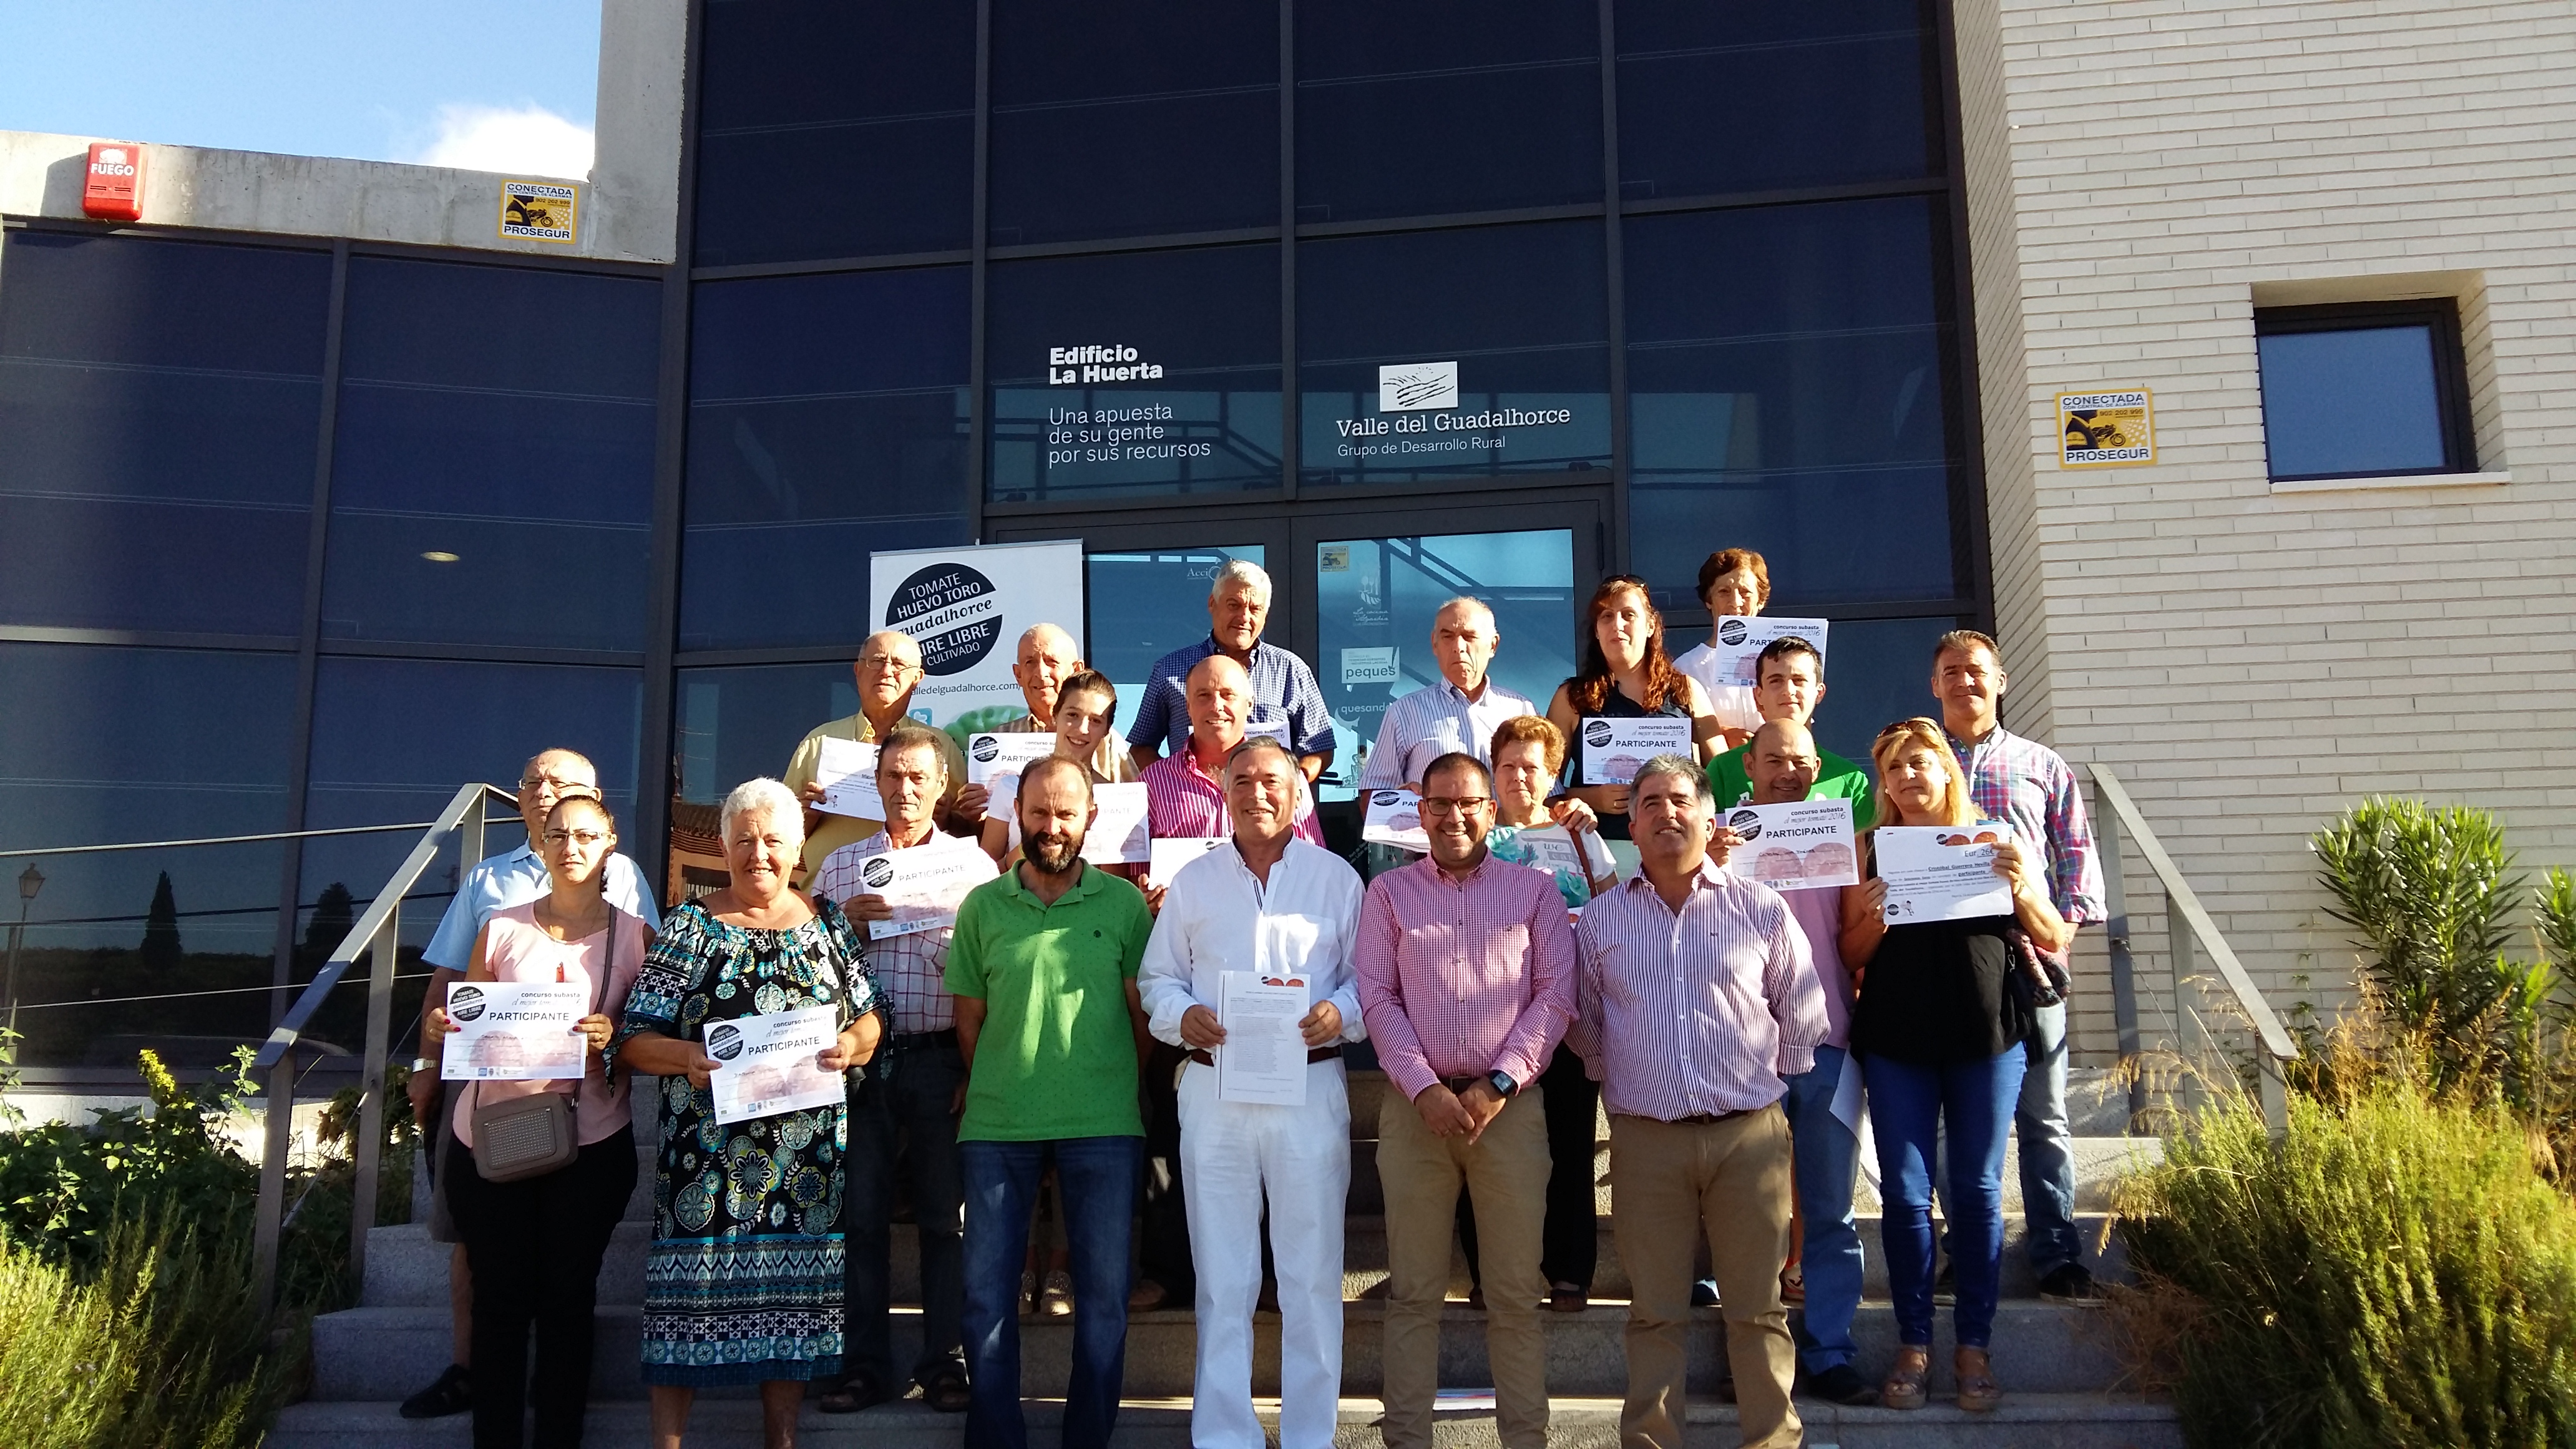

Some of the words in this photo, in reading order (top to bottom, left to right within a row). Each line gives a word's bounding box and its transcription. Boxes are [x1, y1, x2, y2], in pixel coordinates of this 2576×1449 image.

[90, 163, 134, 175] FUEGO
[507, 183, 572, 195] CONECTADA
[504, 226, 570, 238] PROSEGUR
[1050, 344, 1138, 365] Edificio
[1050, 367, 1076, 384] La
[1083, 362, 1163, 383] Huerta
[2062, 394, 2144, 406] CONECTADA
[1050, 407, 1089, 426] Una
[1095, 402, 1173, 427] apuesta
[1336, 418, 1389, 437] Valle
[1395, 414, 1428, 434] del
[1434, 408, 1571, 432] Guadalhorce
[1049, 426, 1073, 444] de
[1079, 430, 1101, 443] su
[1108, 422, 1164, 447] gente
[1049, 449, 1081, 469] por
[1086, 447, 1120, 462] sus
[1126, 442, 1211, 460] recursos
[1337, 444, 1377, 459] Grupo
[1381, 442, 1397, 454] de
[1402, 438, 1468, 454] Desarrollo
[1471, 436, 1506, 449] Rural
[2066, 449, 2149, 462] PROSEGUR
[908, 572, 962, 600] TOMATE
[897, 593, 942, 620] HUEVO
[947, 582, 981, 603] TORO
[920, 637, 945, 656] IRE
[948, 622, 990, 647] LIBRE
[926, 642, 980, 667] CULTIVADO
[1346, 666, 1396, 680] peques
[912, 682, 1020, 696] alledelguadalhorce.com
[1828, 811, 1846, 821] 2016
[1766, 826, 1837, 839] PARTICIPANTE
[899, 864, 966, 881] PARTICIPANTE
[489, 1012, 569, 1021] PARTICIPANTE
[773, 1019, 801, 1028] concurso
[748, 1036, 820, 1055] PARTICIPANTE
